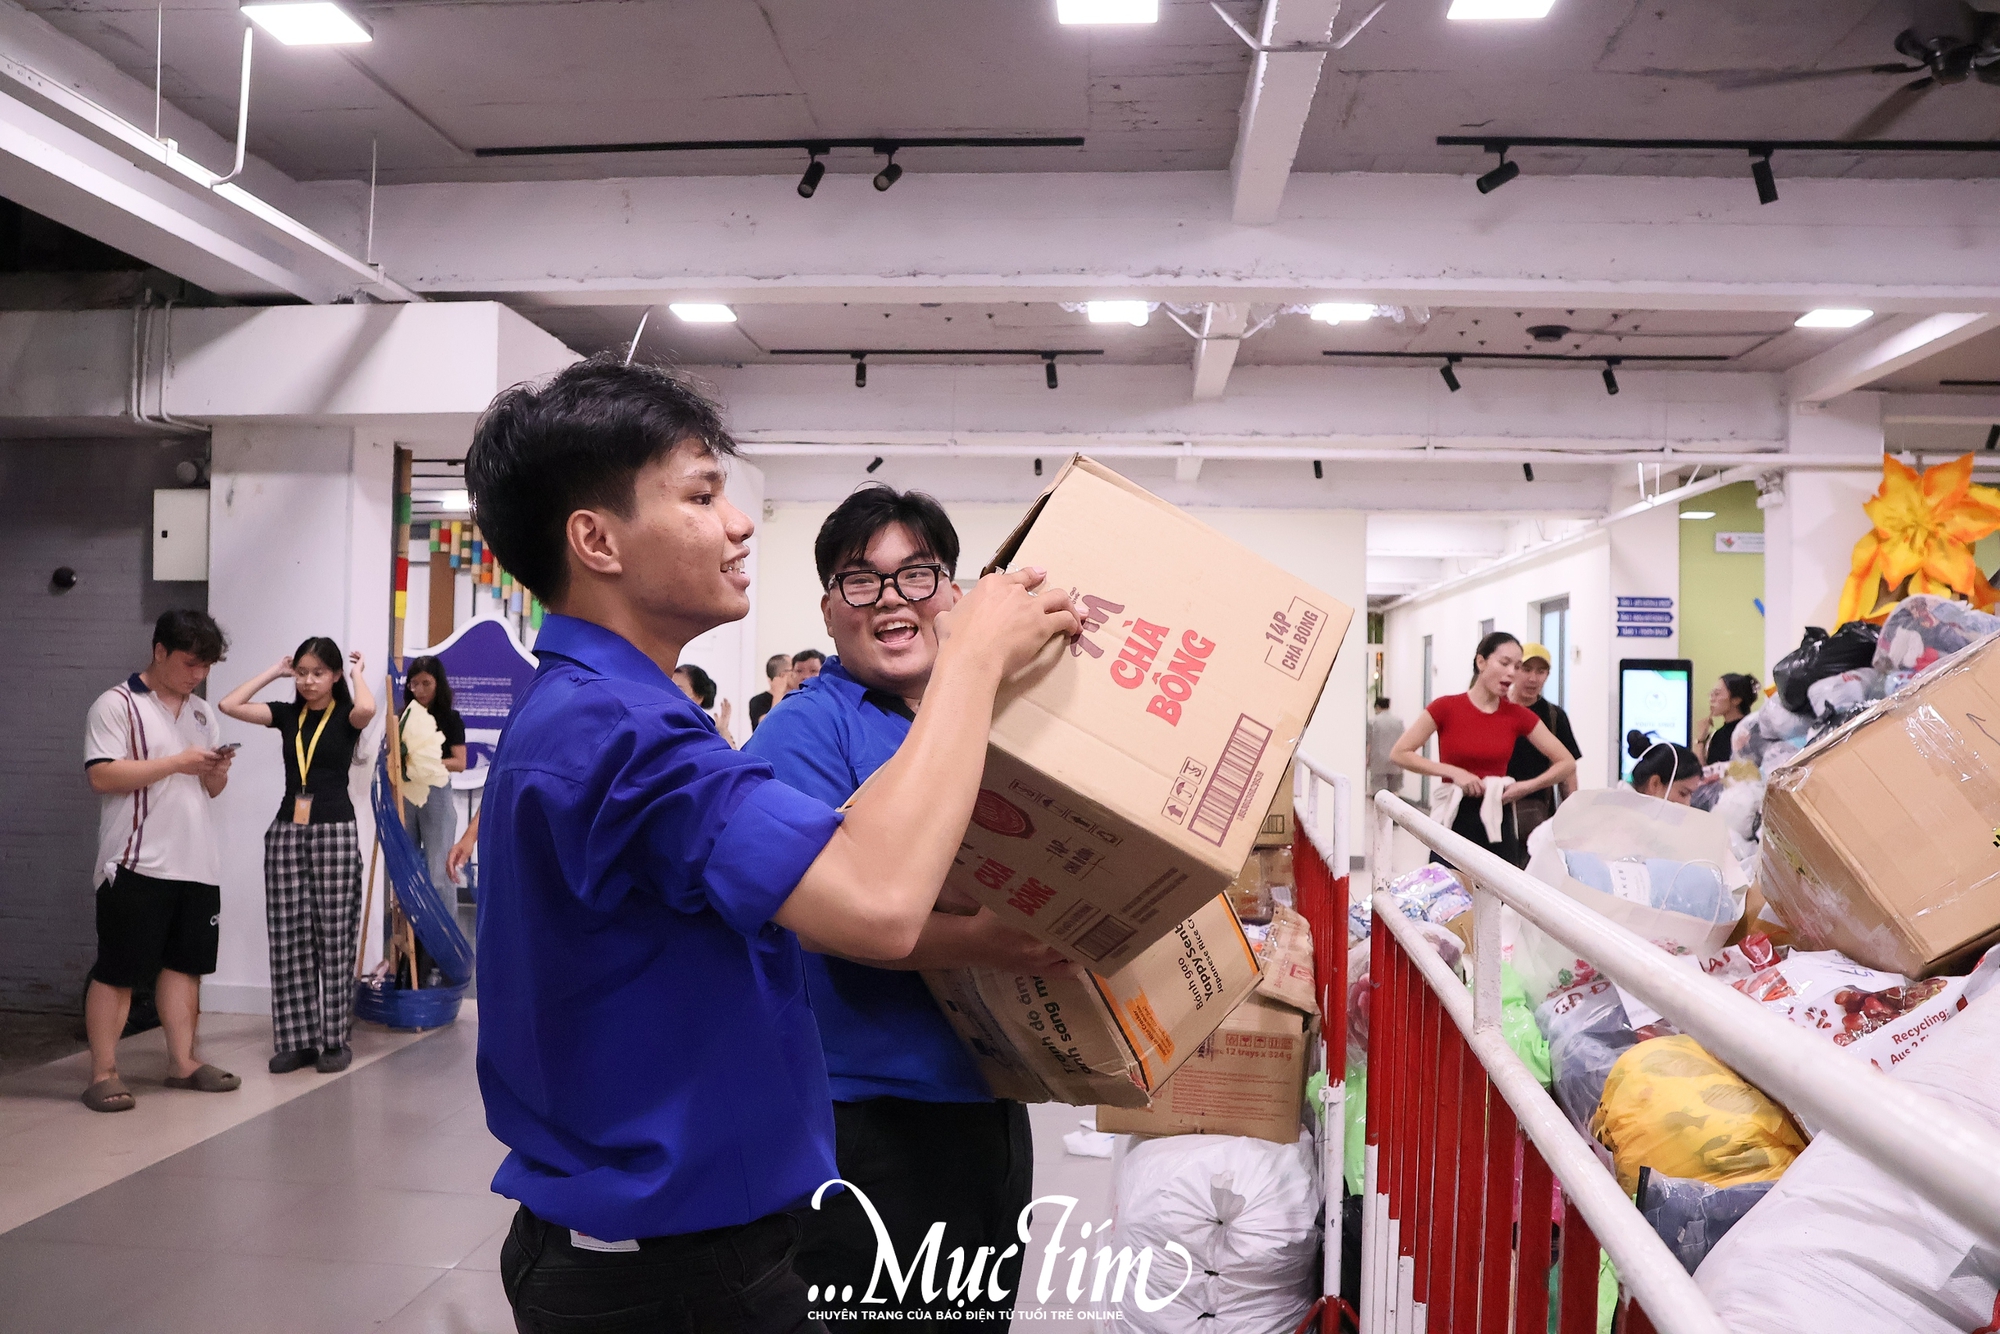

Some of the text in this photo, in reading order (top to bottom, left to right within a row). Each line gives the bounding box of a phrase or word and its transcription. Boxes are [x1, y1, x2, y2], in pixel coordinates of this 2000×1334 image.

[1110, 617, 1170, 690] CHÀ
[1265, 610, 1291, 645] 14P
[1282, 610, 1318, 670] CHÀ BÔNG
[1146, 629, 1217, 727] BÔNG
[1175, 923, 1213, 1001] Yappy Senb
[1193, 929, 1206, 951] Rice
[1178, 957, 1203, 1011] Bánh gạo
[1203, 950, 1224, 993] Japanese
[1225, 1047, 1236, 1056] 12
[1238, 1049, 1259, 1059] trays
